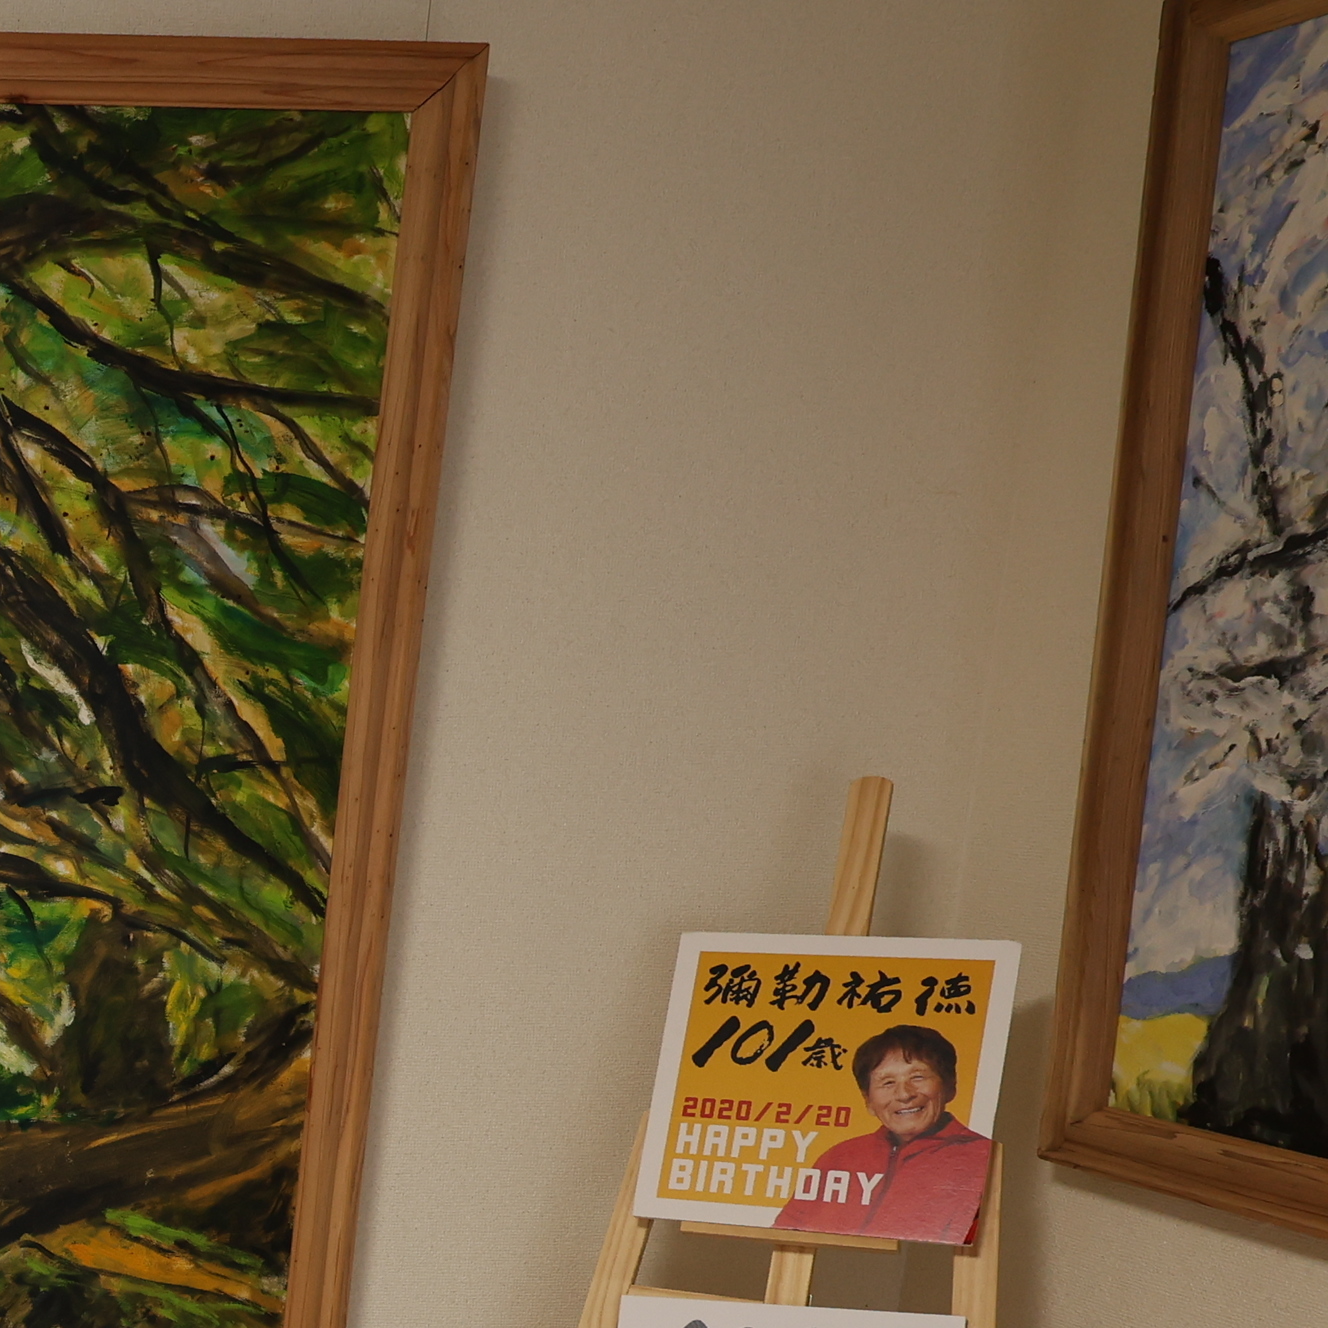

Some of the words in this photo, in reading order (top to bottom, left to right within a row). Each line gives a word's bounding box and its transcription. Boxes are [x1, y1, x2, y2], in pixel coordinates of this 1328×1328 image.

[681, 1096, 852, 1128] 2020/2/20
[675, 1122, 819, 1163] HAPPY
[668, 1157, 885, 1206] BIRTHDAY
